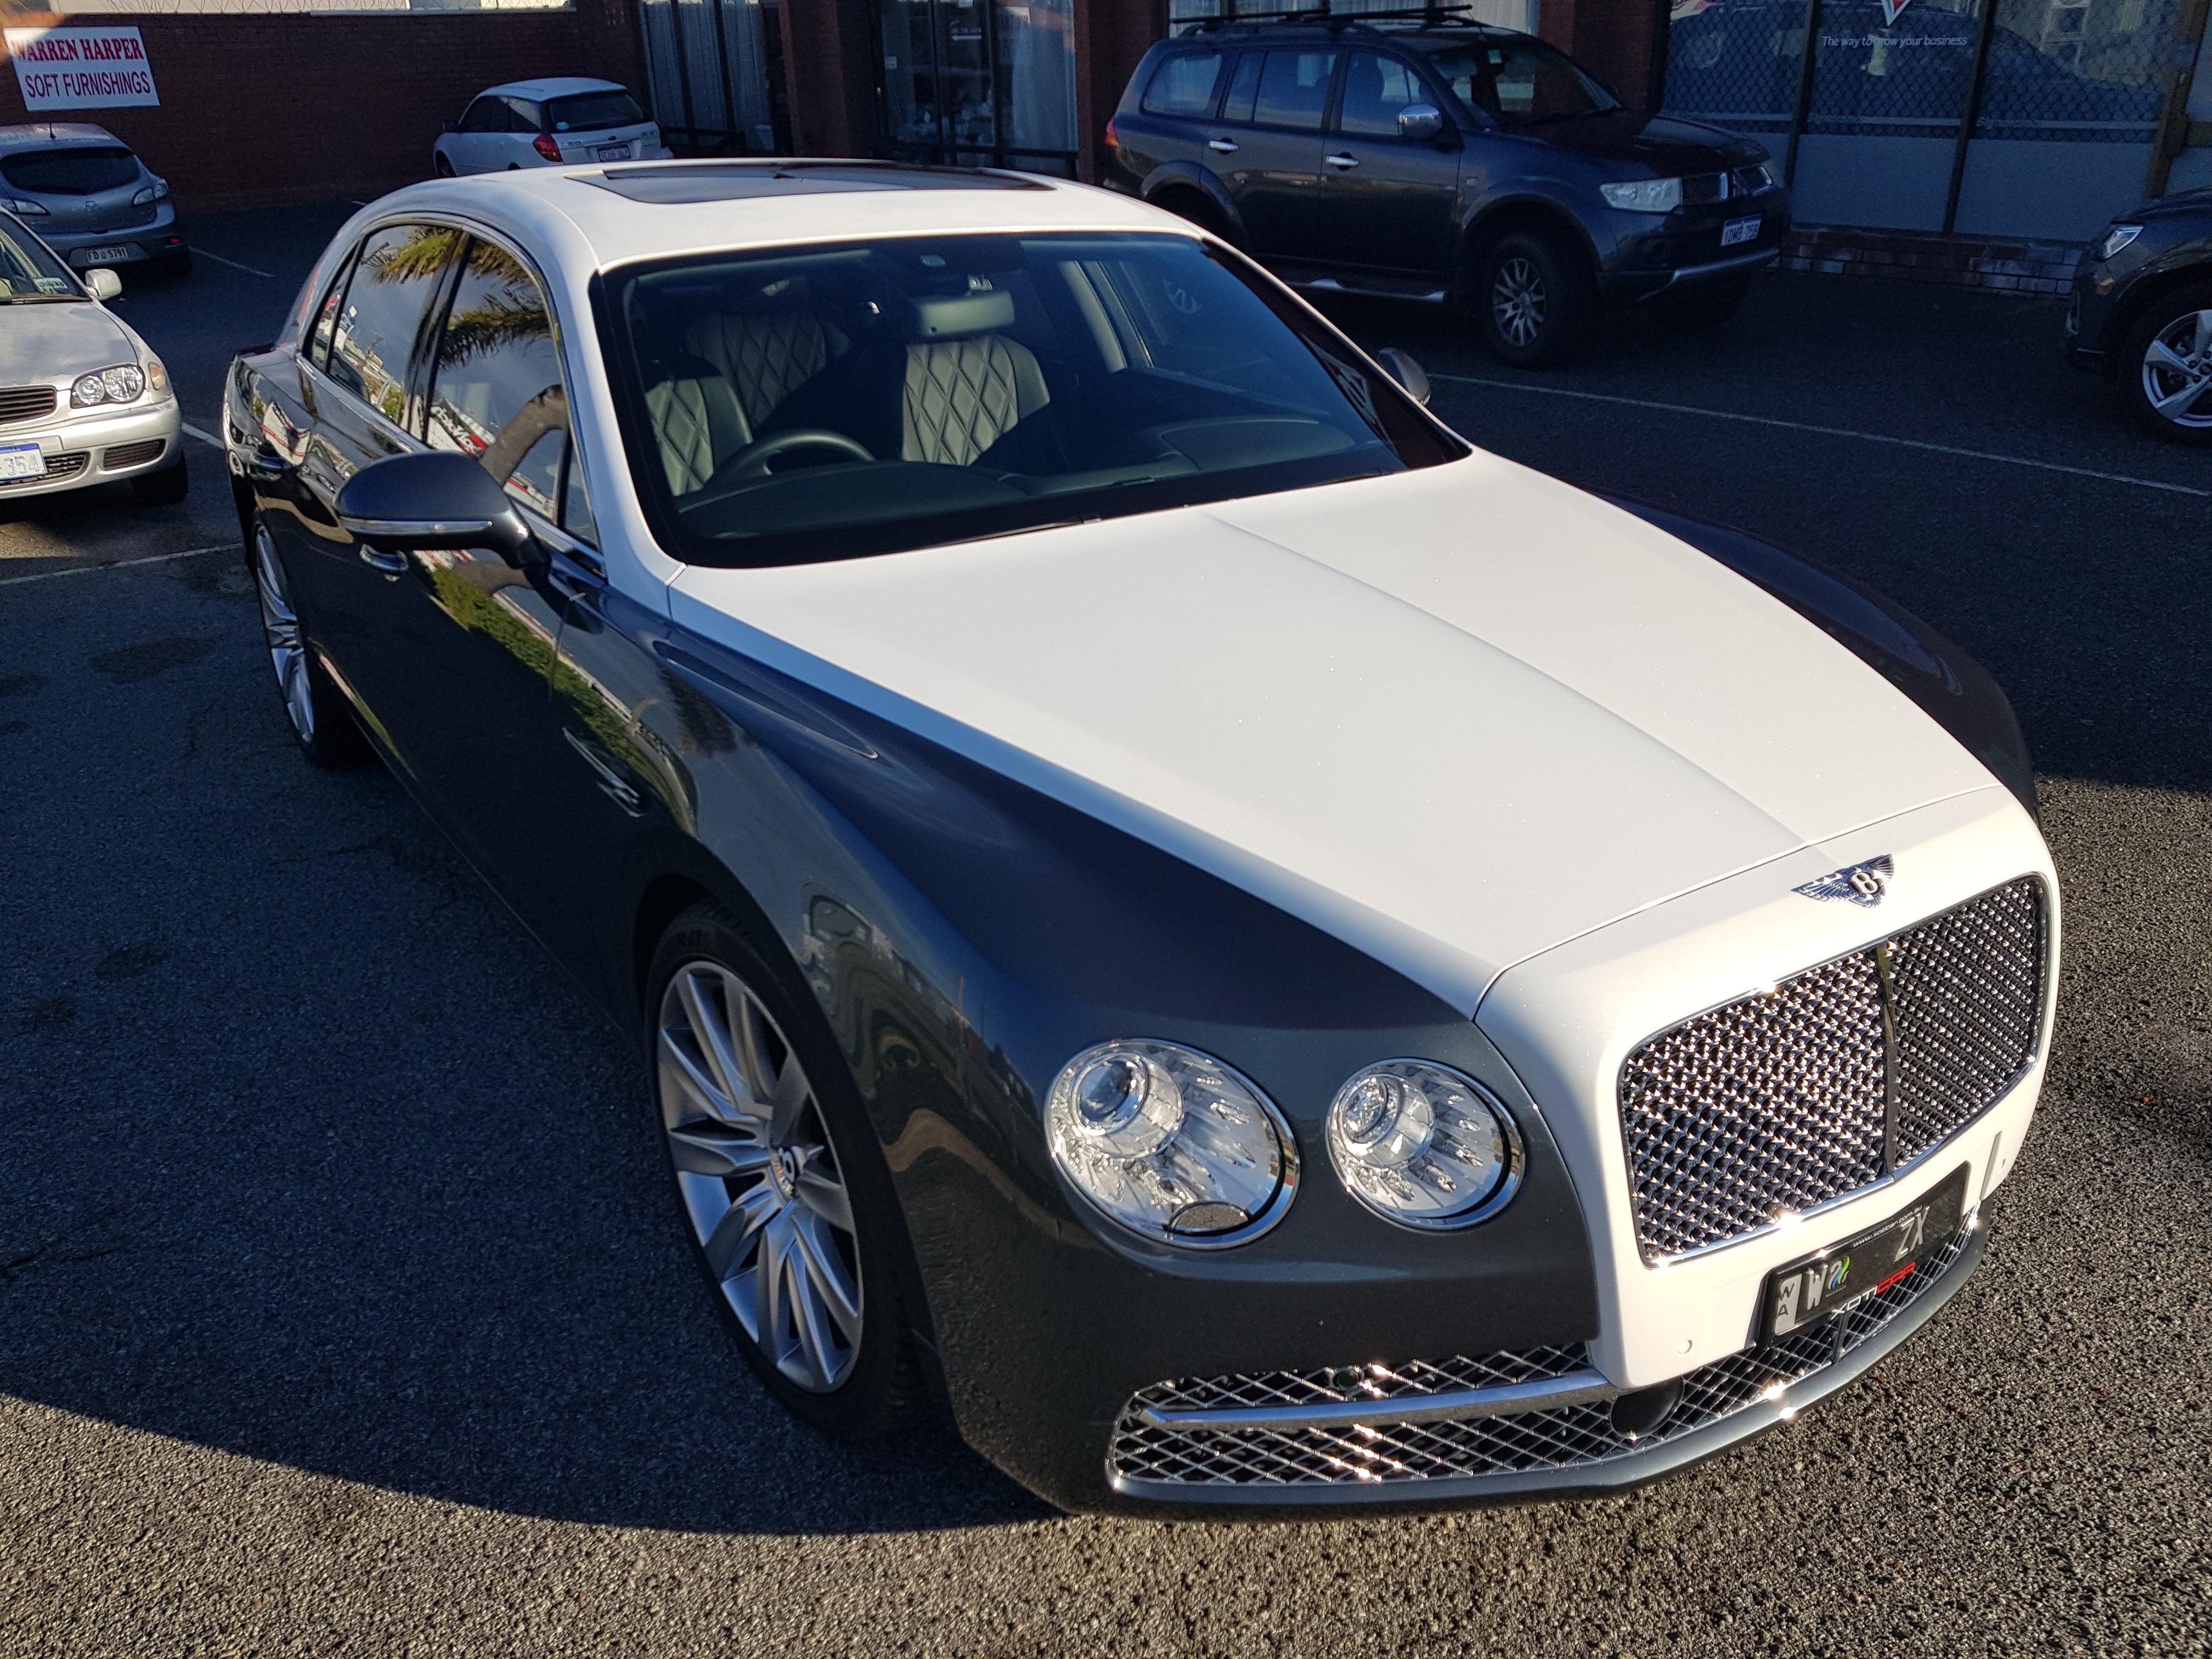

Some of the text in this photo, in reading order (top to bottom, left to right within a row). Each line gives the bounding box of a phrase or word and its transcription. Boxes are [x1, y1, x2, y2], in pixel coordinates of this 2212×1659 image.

[10, 38, 144, 61] WARREN HARPER
[1821, 36, 1839, 46] The
[1841, 37, 1861, 48] way
[1861, 36, 1871, 46] to
[1899, 37, 1923, 48] your
[1924, 35, 1968, 46] business
[25, 71, 150, 98] SOFT FURNISHINGS
